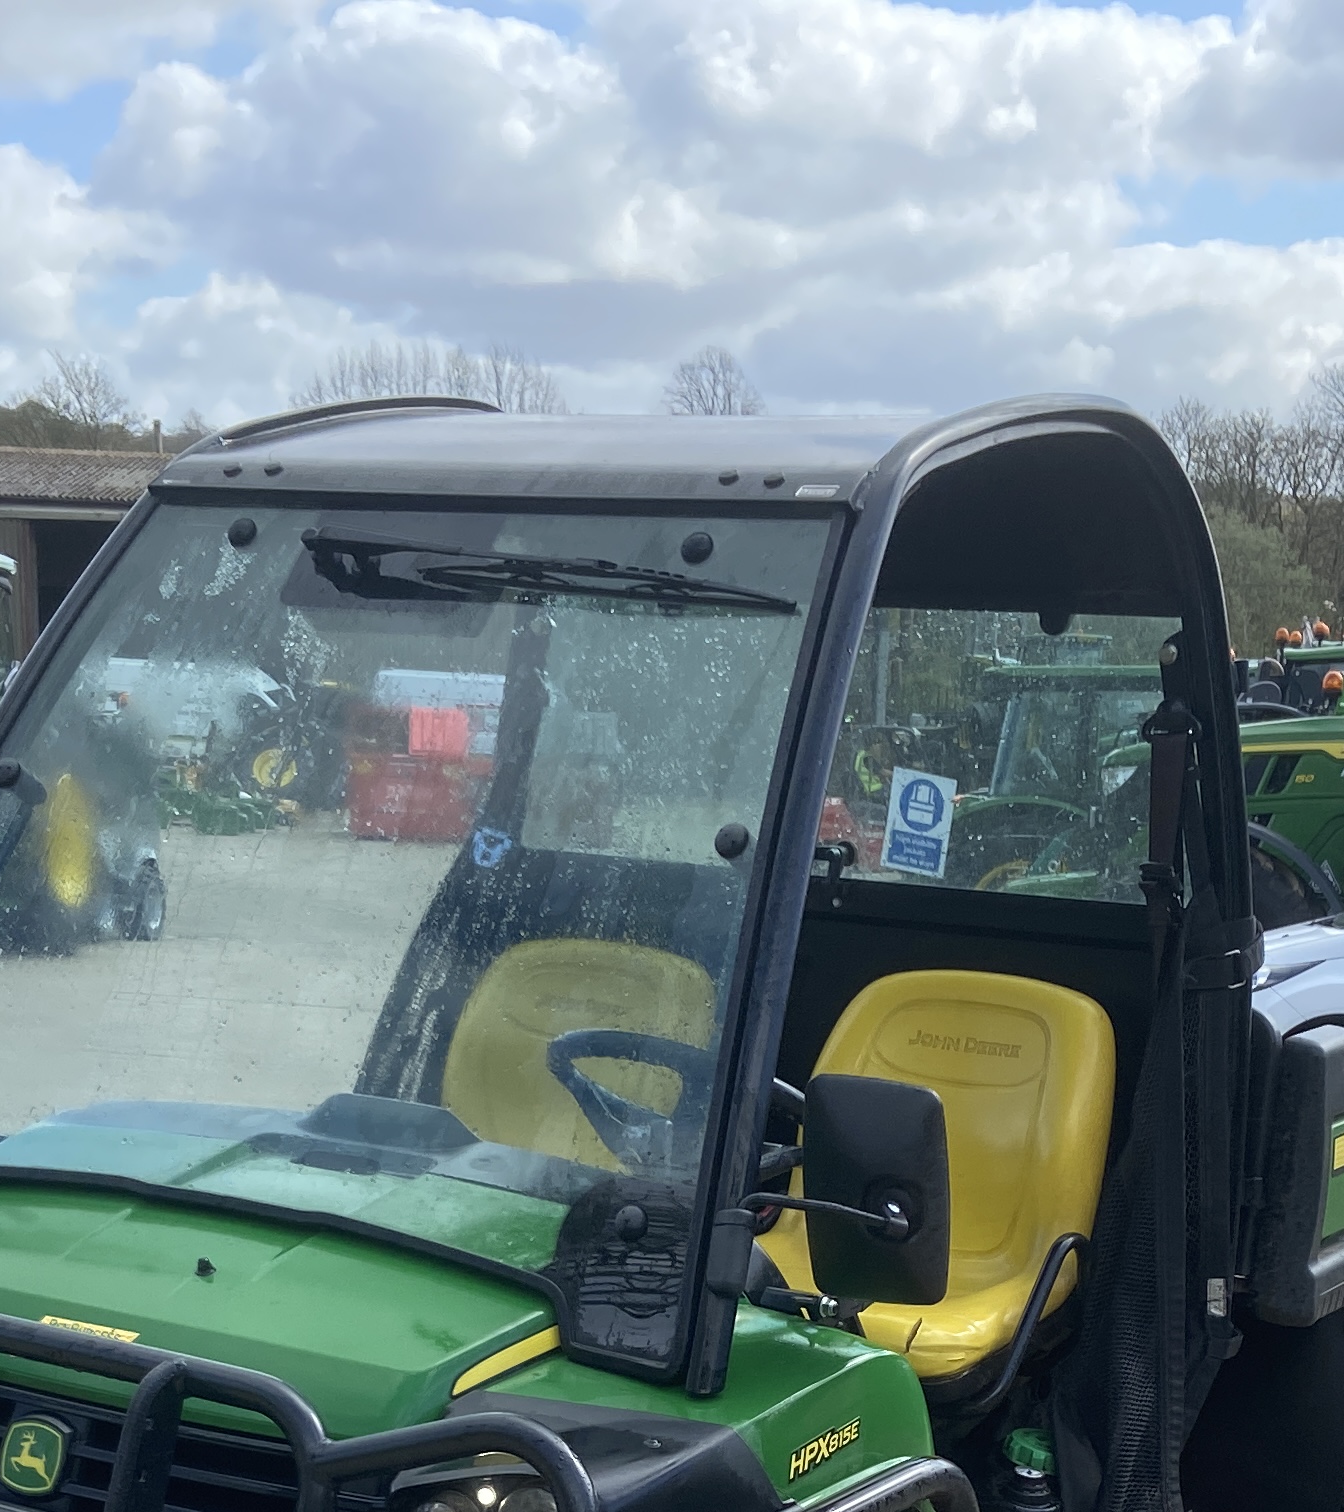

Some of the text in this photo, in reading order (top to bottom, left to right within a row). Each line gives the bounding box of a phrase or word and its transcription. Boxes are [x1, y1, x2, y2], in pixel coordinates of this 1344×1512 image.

[908, 1029, 1022, 1059] JOHN DEERE
[789, 1420, 860, 1480] HPX815E
